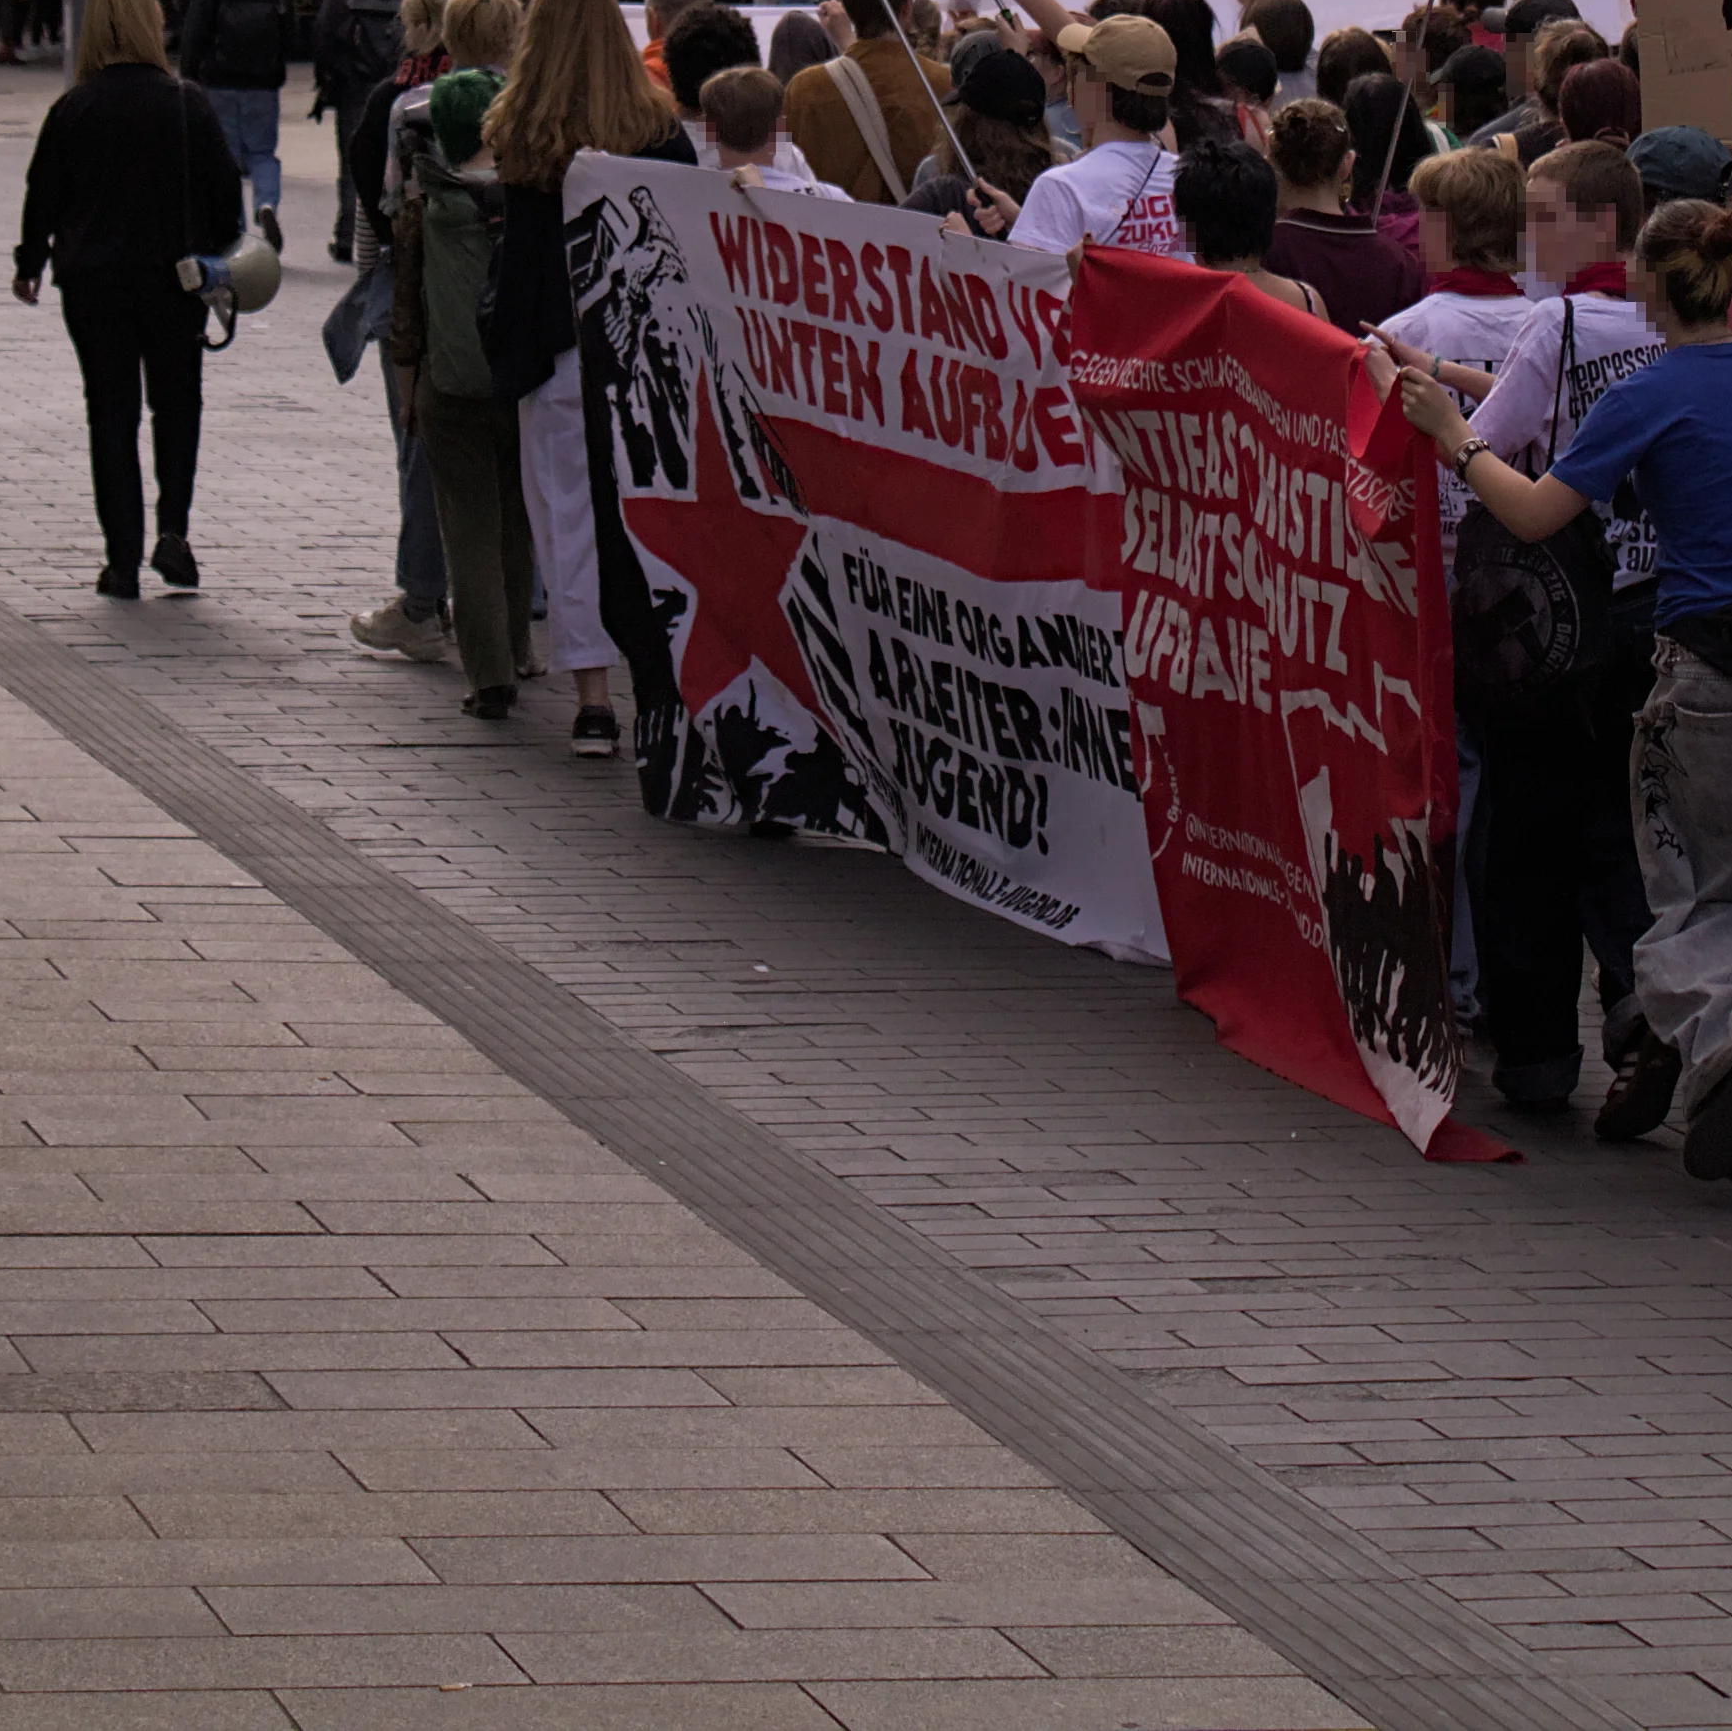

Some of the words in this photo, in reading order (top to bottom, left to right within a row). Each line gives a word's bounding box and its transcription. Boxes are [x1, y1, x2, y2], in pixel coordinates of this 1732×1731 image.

[709, 212, 1009, 361] WIDERSTAND
[1007, 279, 1072, 370] VO
[734, 305, 886, 427] UNTEN
[1290, 408, 1321, 448] UND
[843, 548, 898, 621] FÜR
[895, 575, 954, 647] EINE
[888, 716, 1049, 857] JUGEND!
